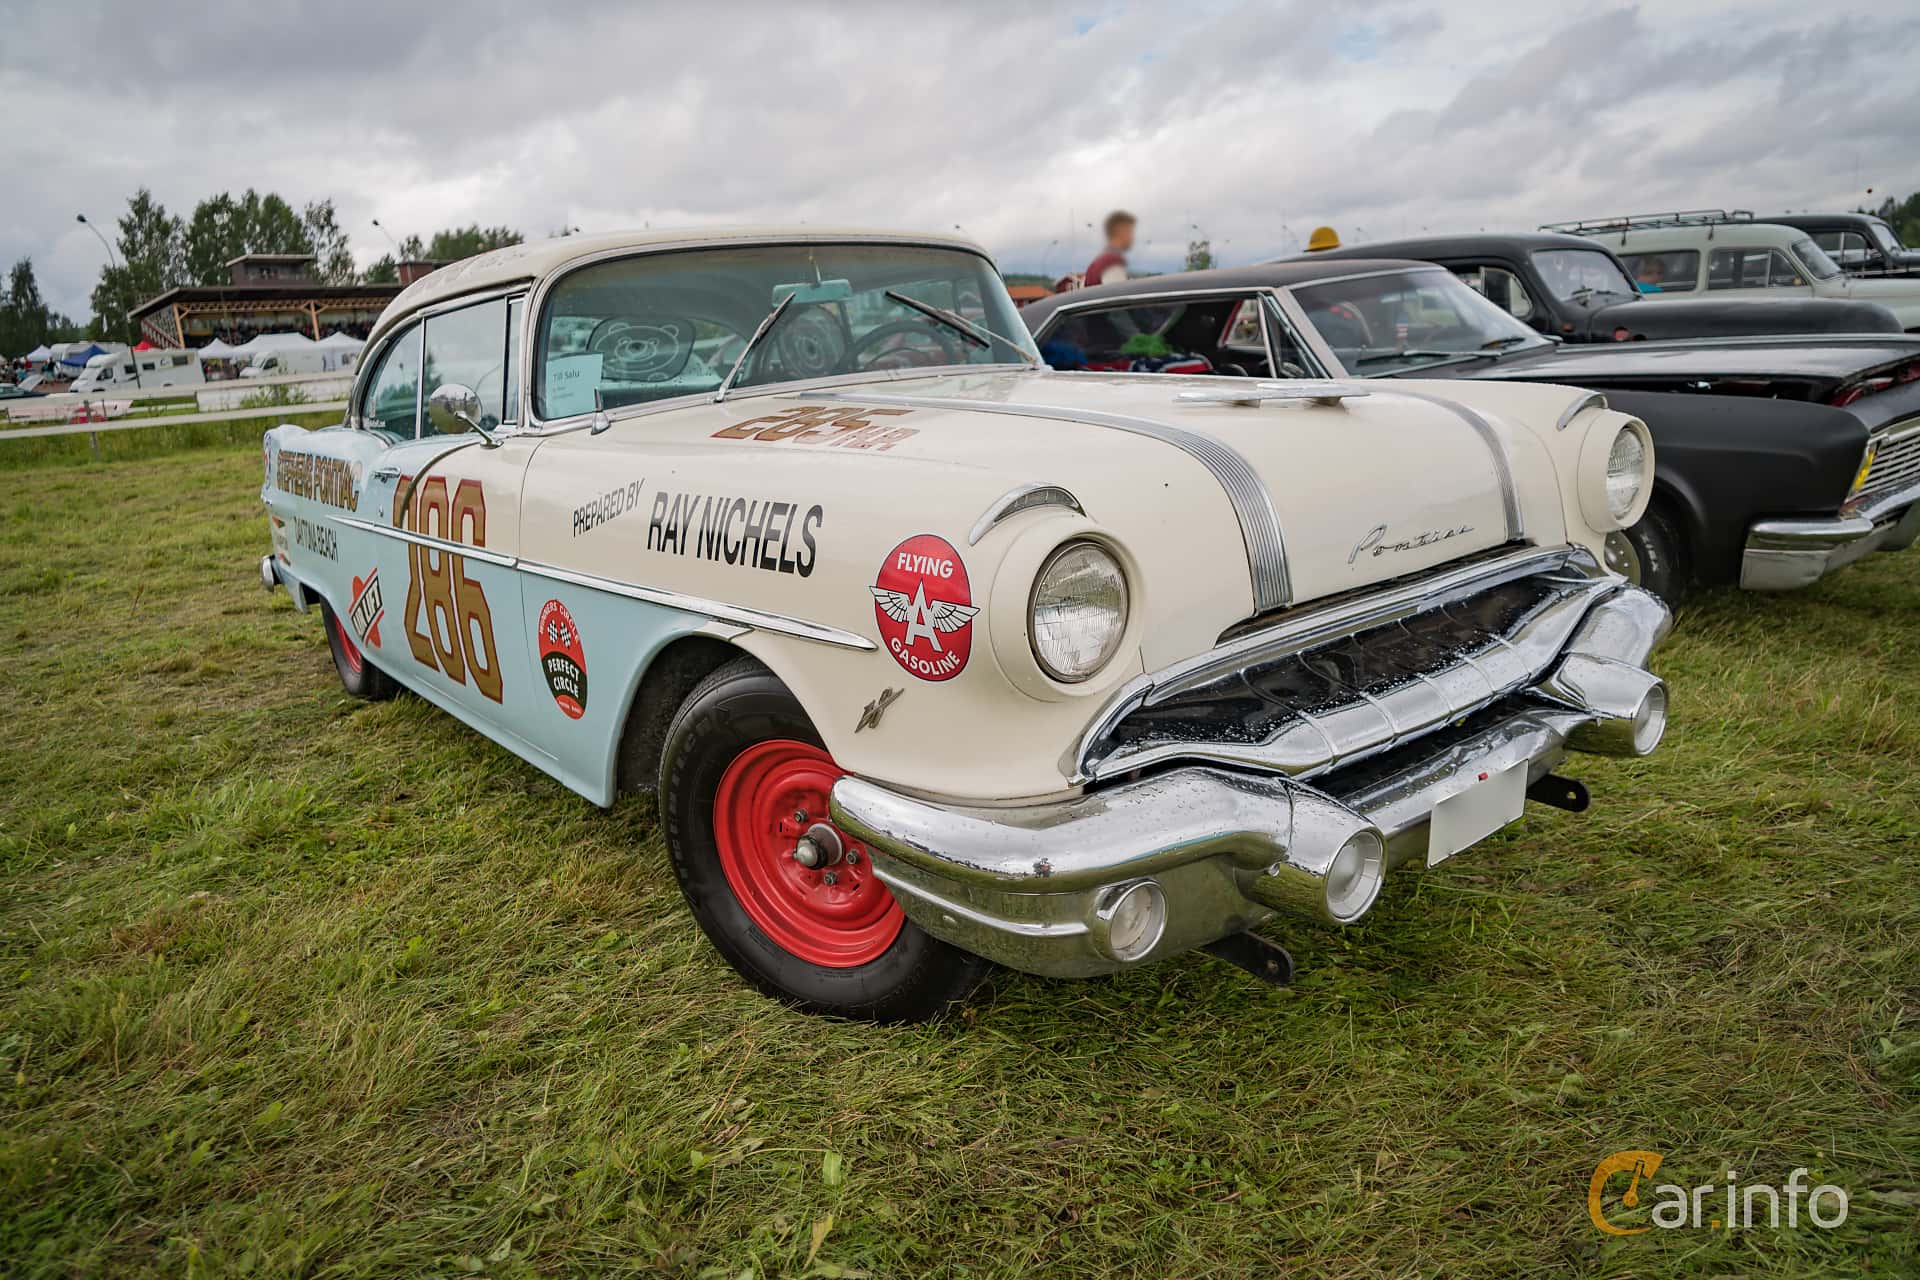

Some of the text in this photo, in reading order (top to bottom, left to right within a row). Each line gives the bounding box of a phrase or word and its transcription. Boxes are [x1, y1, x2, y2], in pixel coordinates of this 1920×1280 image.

[313, 455, 363, 513] PONTIAC
[573, 477, 646, 538] PREPARED BY
[647, 491, 824, 578] RAY NICHELS
[1348, 524, 1475, 565] Pontiac
[897, 552, 954, 579] FLYING
[392, 475, 504, 705] 286
[540, 601, 580, 645] WINNERS CIRCLE
[547, 658, 580, 682] PERFECT
[890, 637, 961, 676] GASOLINE
[553, 676, 579, 699] CIRCLE
